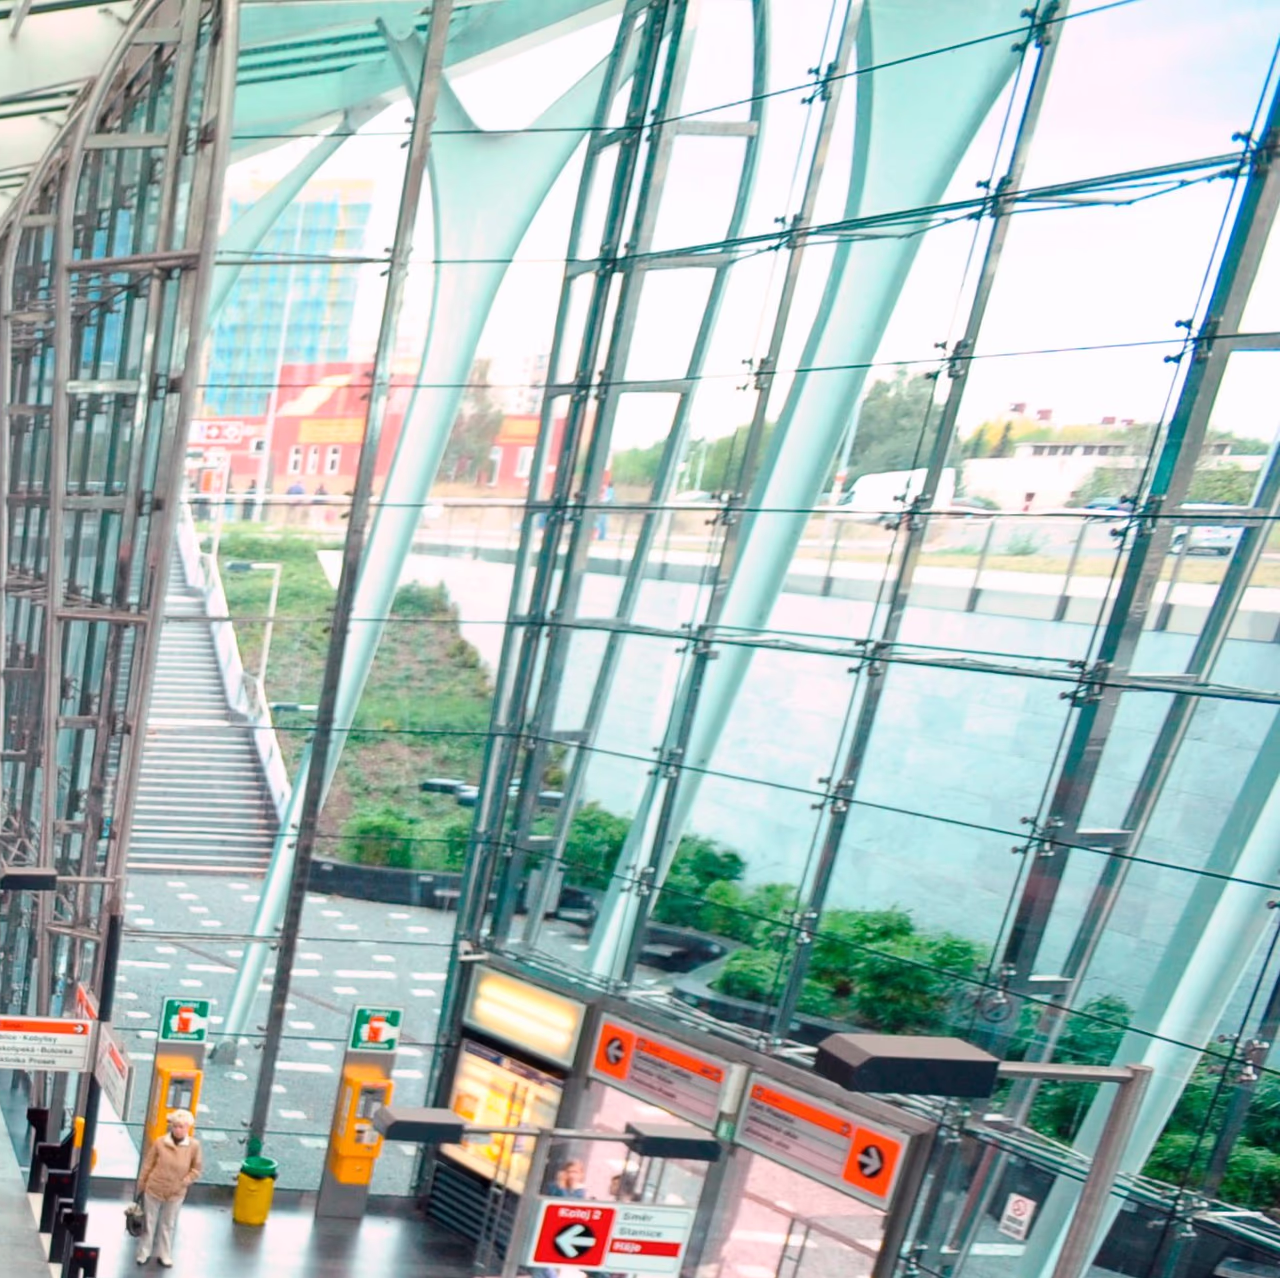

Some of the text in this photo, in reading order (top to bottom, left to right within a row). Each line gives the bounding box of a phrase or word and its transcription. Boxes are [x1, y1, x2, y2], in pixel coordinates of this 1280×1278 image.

[557, 1206, 603, 1222] Kolej 2
[623, 1211, 653, 1222] Směr
[618, 1226, 663, 1239] Stanice
